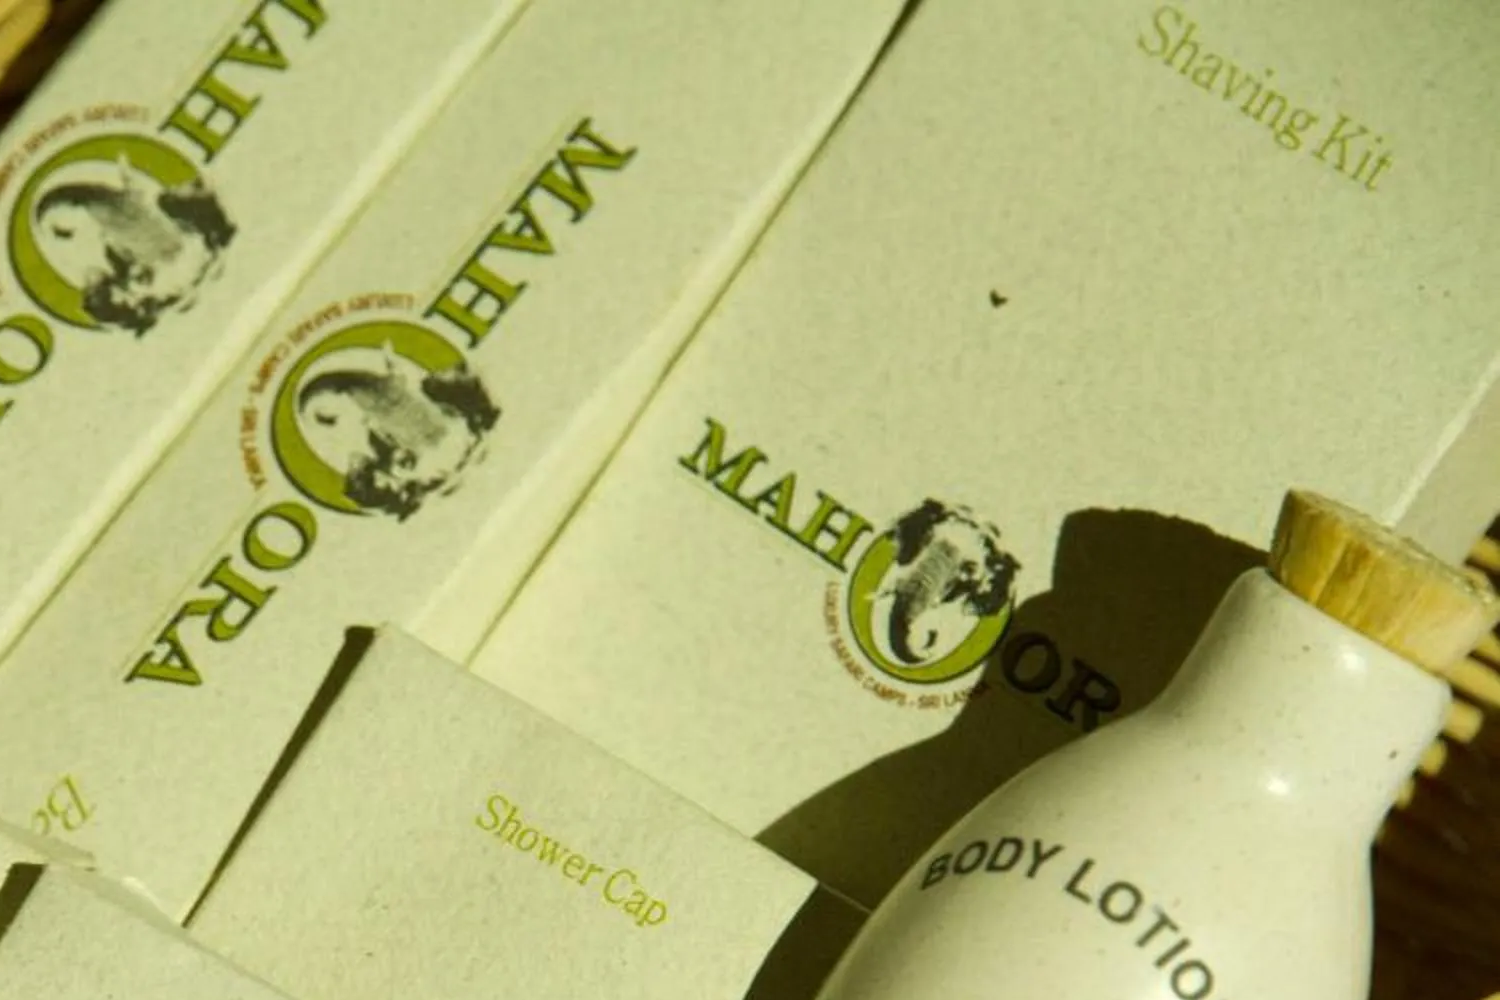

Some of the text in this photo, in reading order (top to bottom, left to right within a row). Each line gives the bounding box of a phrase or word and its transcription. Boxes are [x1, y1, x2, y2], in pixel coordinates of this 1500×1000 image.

[1137, 5, 1392, 191] Shaving Kit
[124, 117, 638, 688] MAHOORA
[678, 418, 1122, 731] MAHOOR
[475, 795, 667, 927] Shower Cap
[920, 837, 1065, 889] BODY
